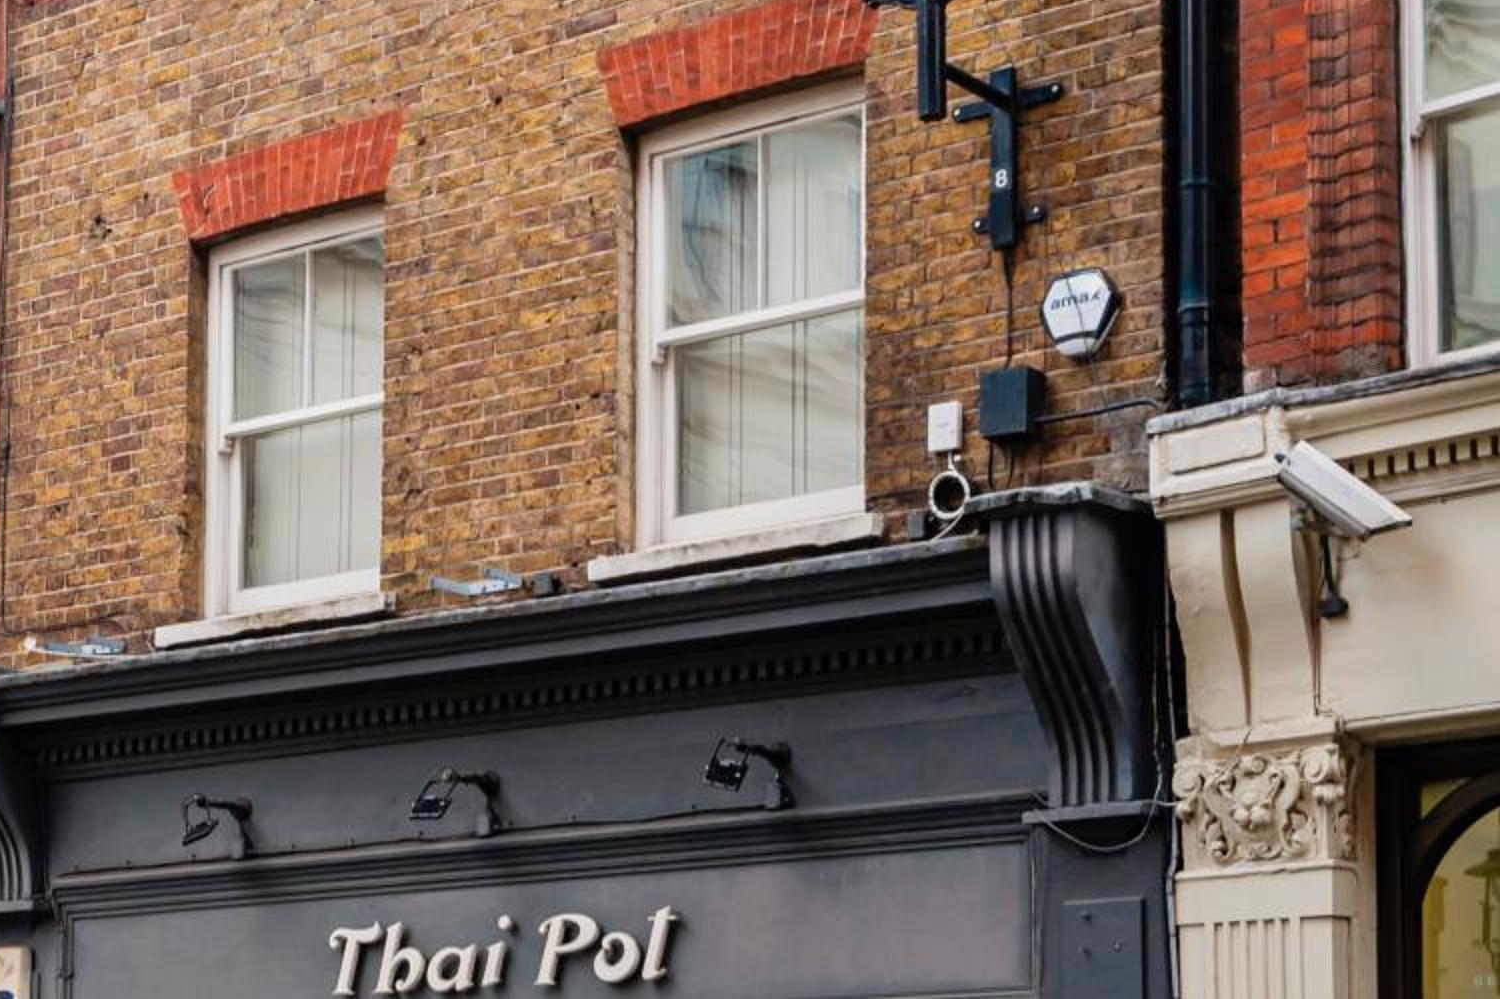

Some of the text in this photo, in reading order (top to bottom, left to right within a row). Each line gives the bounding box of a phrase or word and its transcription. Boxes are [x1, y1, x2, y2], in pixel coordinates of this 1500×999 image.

[995, 168, 1008, 188] 8
[328, 905, 680, 996] Thai Pot
